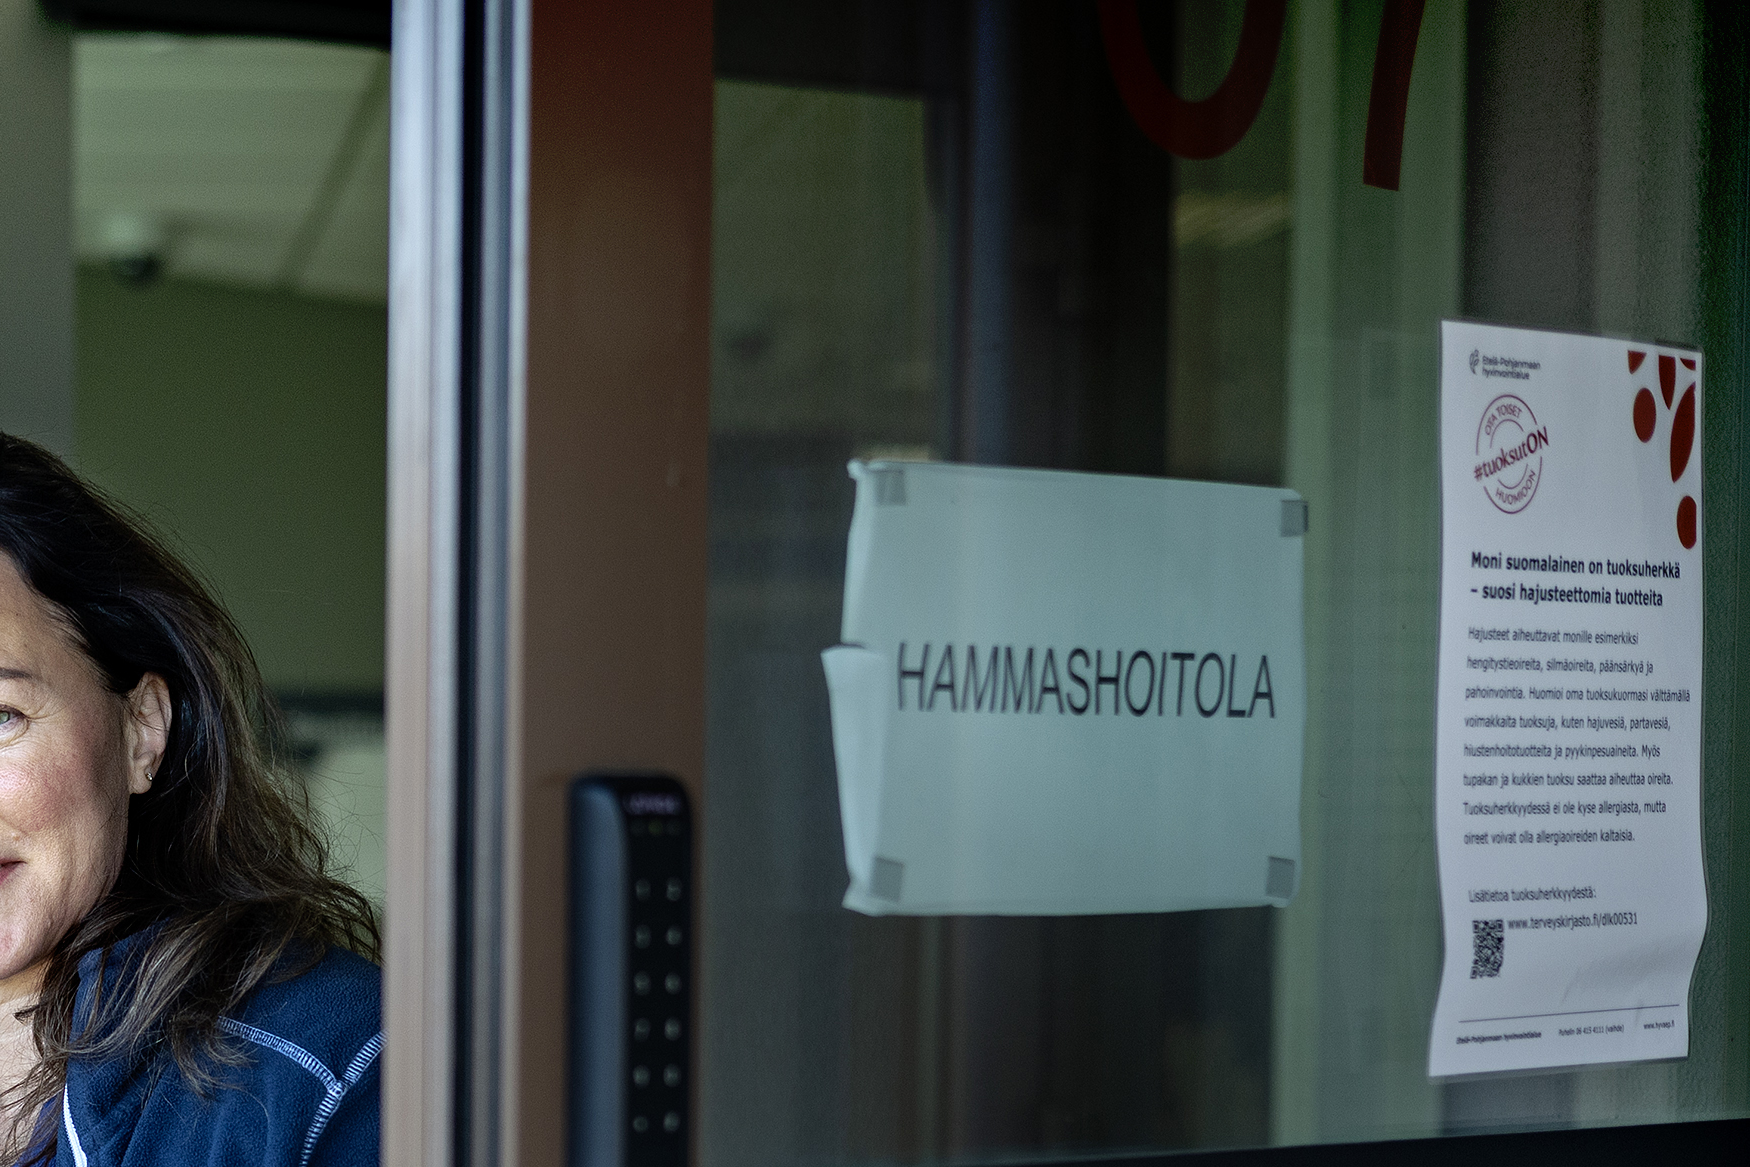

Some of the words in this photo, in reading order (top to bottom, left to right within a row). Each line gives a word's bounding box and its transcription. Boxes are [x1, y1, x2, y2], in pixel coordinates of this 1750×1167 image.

[1485, 413, 1498, 436] OTA
[1496, 403, 1523, 419] TOISET
[1474, 426, 1550, 482] #tuoksutON
[1471, 552, 1502, 571] Moni
[1506, 555, 1585, 574] suomalainen
[1589, 562, 1603, 575] on
[1607, 559, 1681, 579] tuoksuherkkä
[1482, 583, 1515, 601] suosi
[1520, 583, 1611, 606] hajusteettomia
[1615, 588, 1663, 607] tuotteita
[1468, 627, 1510, 643] Hajusteet
[1512, 629, 1561, 643] aiheuttavat
[1563, 630, 1592, 644] monille
[1595, 631, 1639, 645] esimerkiksi
[1467, 656, 1543, 673] hengitystieoireita,
[1546, 658, 1596, 674] silmäoireita,
[1599, 660, 1644, 675] päänsärkyä
[1645, 662, 1654, 676] ja
[897, 641, 1276, 719] HAMMASHOITOLA
[1465, 686, 1526, 702] pahoinvointia.
[1529, 687, 1564, 701] Huomioi
[1566, 690, 1584, 701] oma
[1586, 688, 1648, 702] tuoksukuormasi
[1650, 688, 1690, 702] välttämällä
[1464, 715, 1517, 729] voimakkaita
[1519, 716, 1558, 731] tuoksuja,
[1561, 715, 1584, 729] kuten
[1587, 716, 1627, 731] hajuvesiä,
[1629, 717, 1671, 731] partavesiä,
[1463, 744, 1552, 758] hiustenhoitotuotteita
[1554, 745, 1563, 759] ja
[1565, 744, 1639, 760] pyykinpesuaineita.
[1641, 744, 1661, 759] Myös
[1463, 773, 1498, 788] tupakan
[1500, 773, 1509, 788] ja
[1512, 772, 1544, 786] kukkien
[1546, 772, 1575, 786] tuoksu
[1577, 772, 1606, 785] saattaa
[1609, 772, 1646, 785] aiheuttaa
[1647, 772, 1674, 785] oireita.
[1463, 801, 1550, 817] Tuoksuherkkyydessä
[1553, 801, 1561, 815] ei
[1563, 801, 1575, 814] ole
[1577, 801, 1596, 816] kyse
[1598, 800, 1641, 816] allergiasta,
[1643, 800, 1666, 813] mutta
[1463, 831, 1489, 845] oireet
[1491, 831, 1517, 844] voivat
[1519, 830, 1534, 844] olla
[1536, 829, 1598, 846] allergiaoireiden
[1600, 828, 1635, 842] kaltaisia.
[1468, 889, 1509, 903] Lisätietoa
[1510, 886, 1596, 902] tuoksuherkkyydestä:
